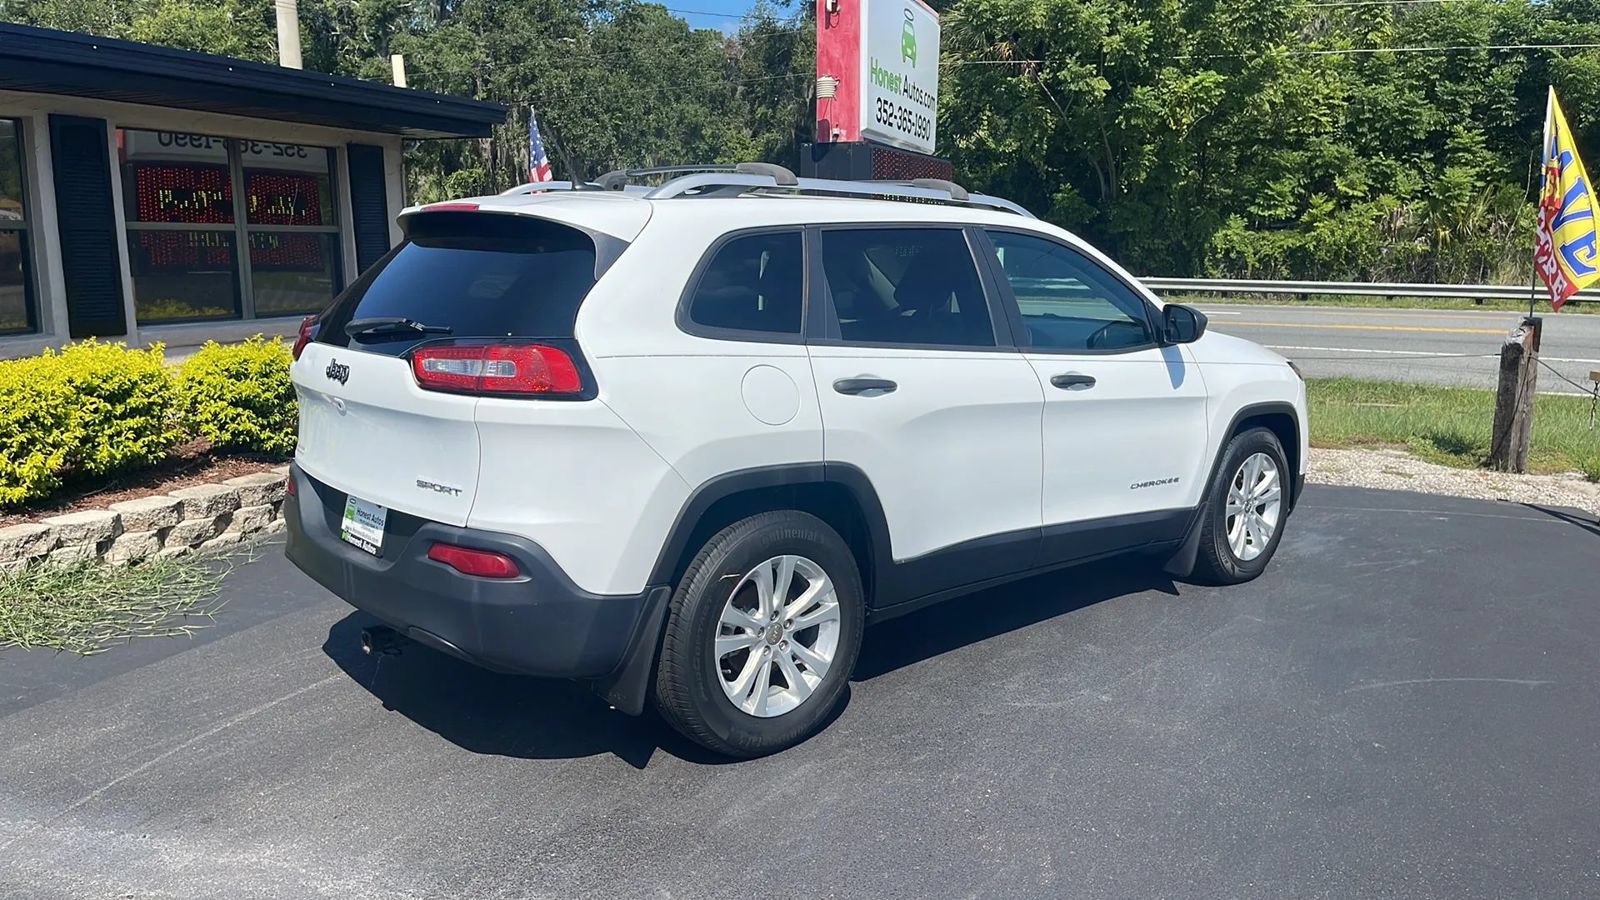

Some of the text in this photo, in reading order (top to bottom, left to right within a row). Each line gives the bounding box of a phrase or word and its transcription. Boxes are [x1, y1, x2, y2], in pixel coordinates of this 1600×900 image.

[876, 97, 931, 142] 352-365-1990
[326, 358, 350, 386] Jeep
[416, 479, 463, 497] SPORT
[1130, 477, 1180, 490] CHEROKEE
